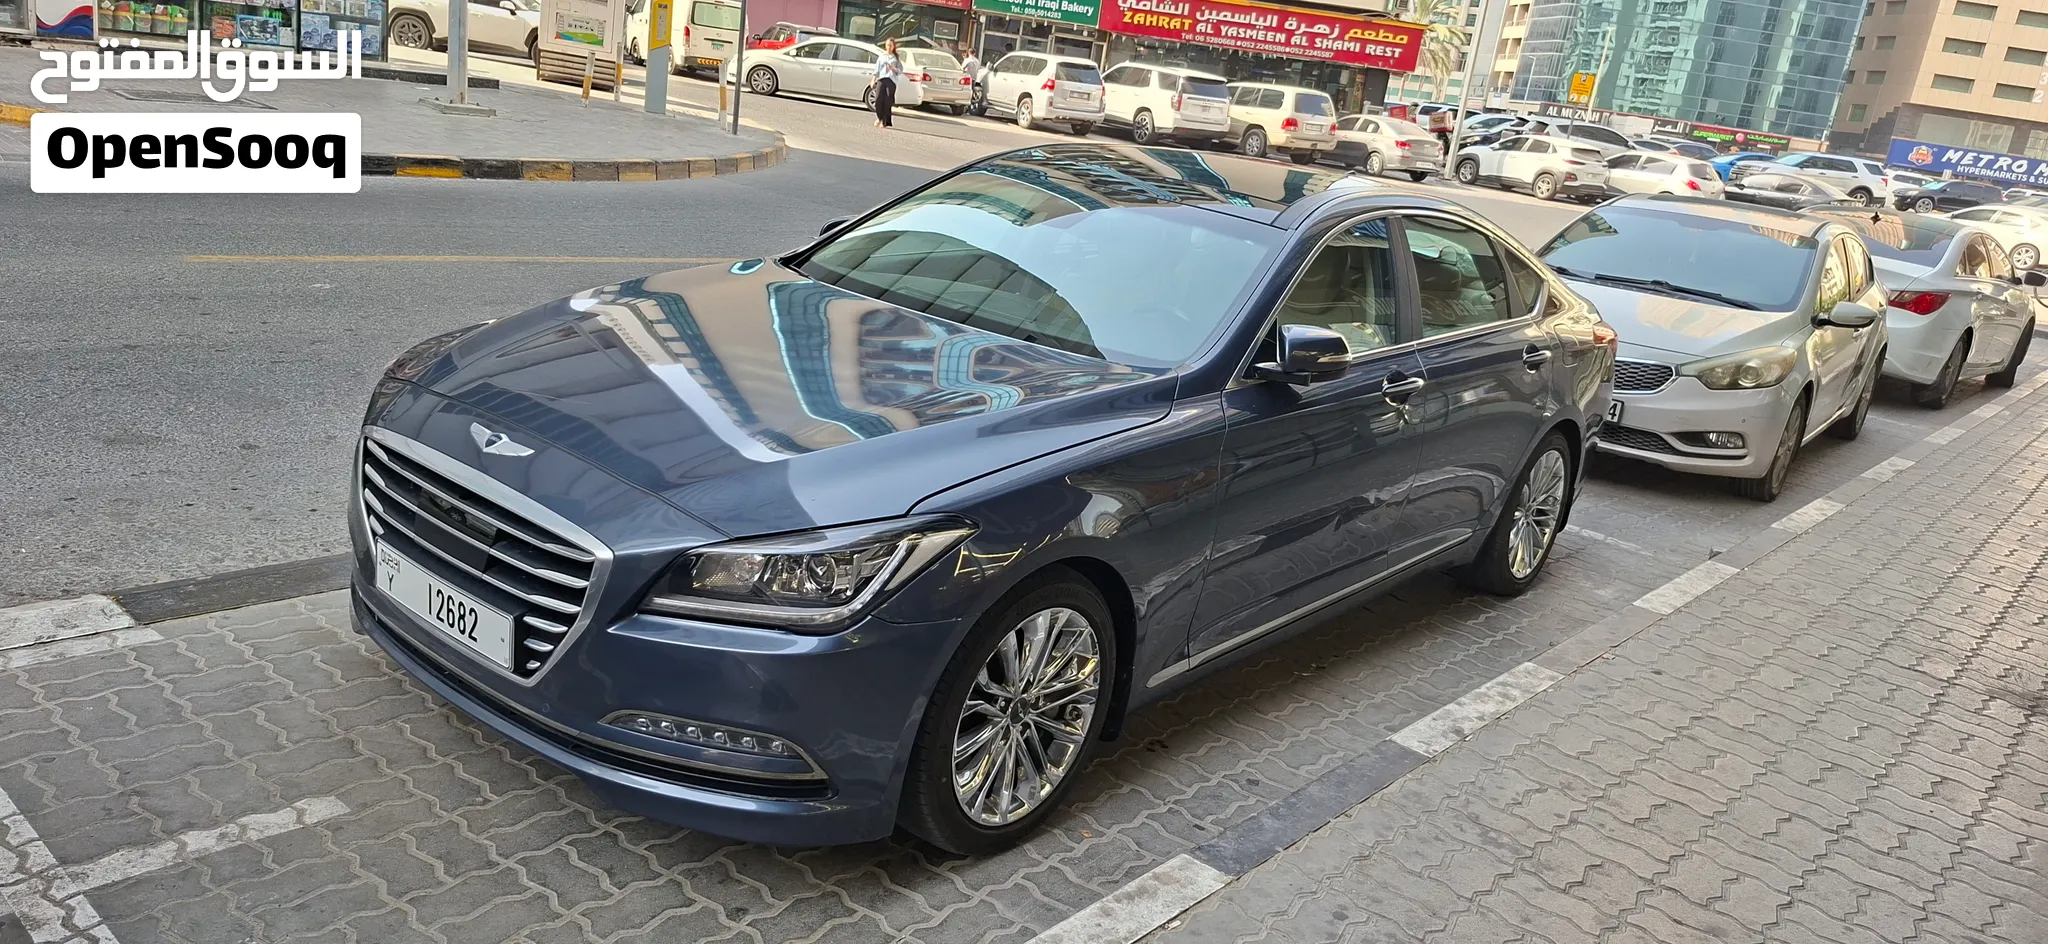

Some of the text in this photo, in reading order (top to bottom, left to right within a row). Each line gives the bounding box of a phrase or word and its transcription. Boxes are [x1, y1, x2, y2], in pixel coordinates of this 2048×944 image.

[1037, 0, 1059, 12] Iraqi
[1061, 2, 1094, 17] Bakery
[1195, 6, 1278, 29] الياسمين
[1122, 11, 1403, 58] ZAHRAT AL YASMEEN AL SHAMI REST
[1284, 16, 1340, 39] زهرة
[1344, 26, 1409, 45] مطعم
[1546, 106, 1558, 116] AL
[1941, 149, 2027, 173] METRO
[1957, 165, 2028, 182] HYPERMARKETS
[2029, 175, 2036, 183] &
[1608, 403, 1618, 420] 4
[387, 570, 394, 591] Y
[428, 583, 478, 643] 12682
